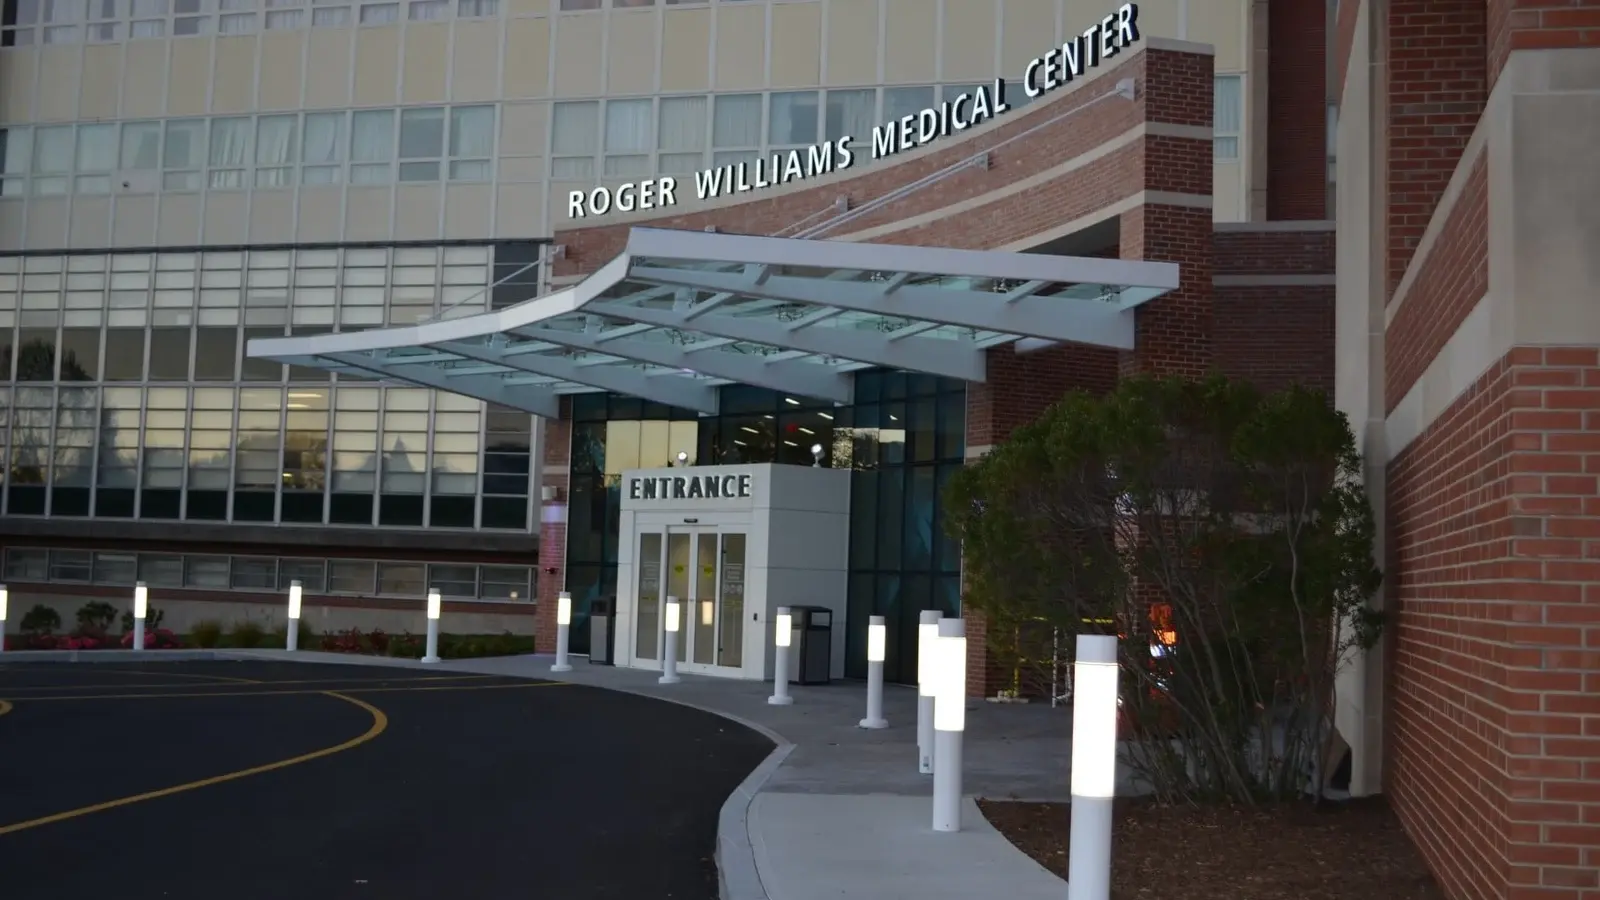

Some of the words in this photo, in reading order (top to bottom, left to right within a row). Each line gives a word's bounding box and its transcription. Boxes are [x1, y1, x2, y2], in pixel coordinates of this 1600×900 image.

[568, 176, 676, 218] ROGER
[695, 135, 853, 199] WILLIAMS
[872, 78, 1008, 159] MEDICAL
[1024, 3, 1139, 97] CENTER
[630, 474, 752, 500] ENTRANCE
